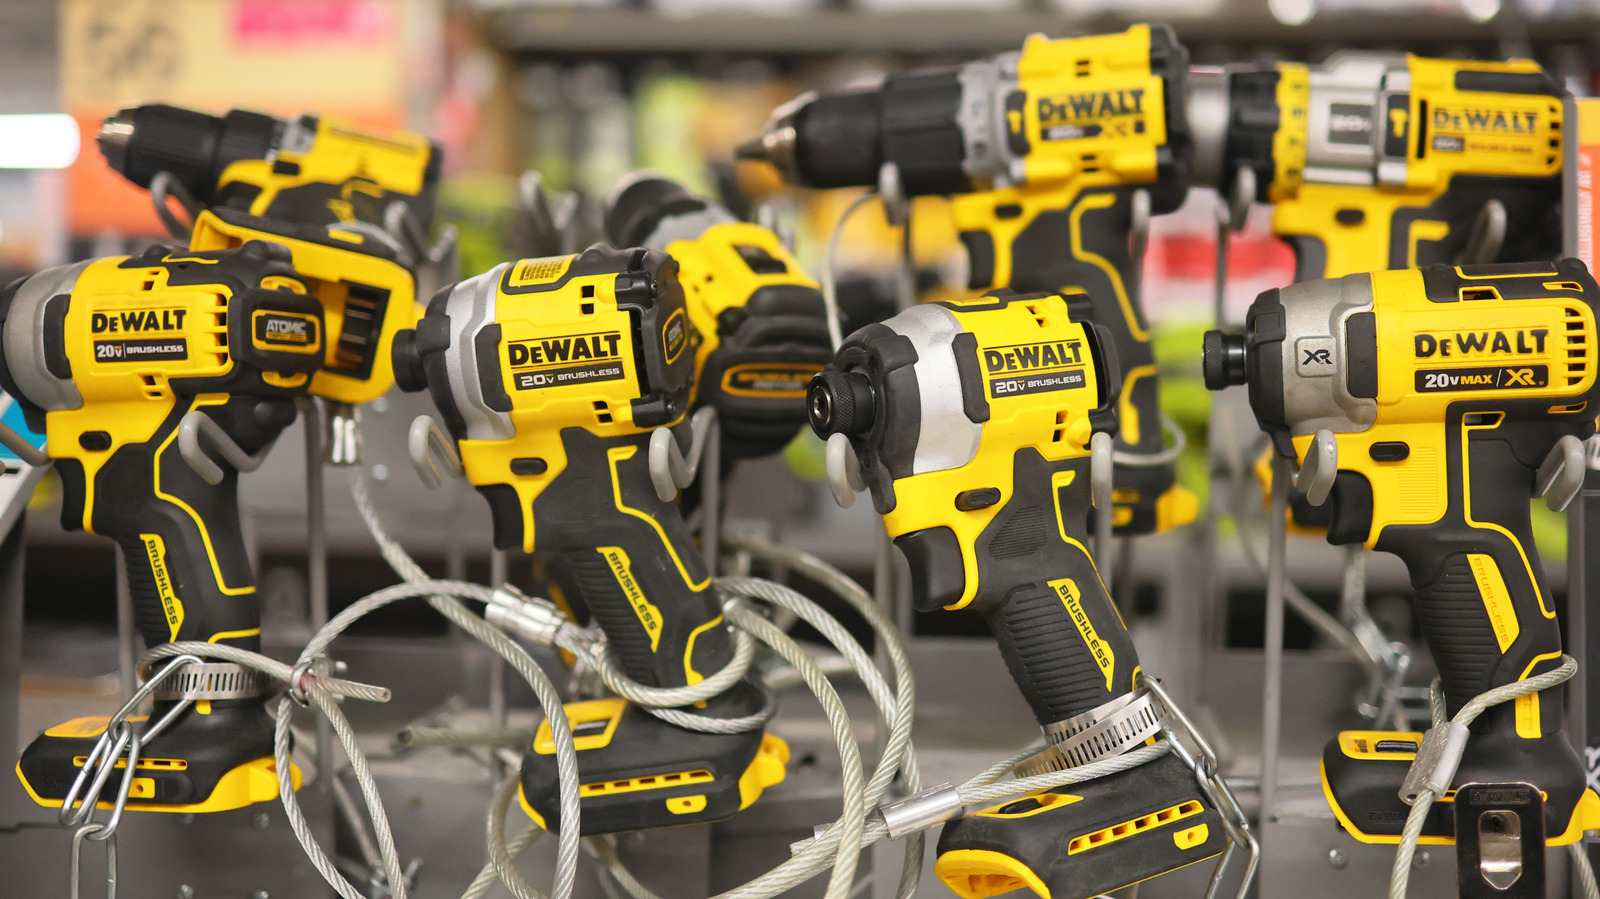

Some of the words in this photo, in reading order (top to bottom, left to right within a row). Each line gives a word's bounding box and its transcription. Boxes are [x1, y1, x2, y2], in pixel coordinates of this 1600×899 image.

[91, 309, 187, 333] DEWALT
[266, 319, 307, 335] ATOMIC
[126, 344, 184, 354] BRUSHLESS
[508, 333, 621, 366] DEWALT
[983, 341, 1082, 372] DEWALT
[1302, 349, 1333, 366] XR
[1415, 329, 1548, 358] DEWALT
[557, 367, 620, 381] BRUSHLESS
[1027, 375, 1082, 388] BRUSHLESS
[147, 540, 179, 625] BRUSHLESS
[608, 552, 657, 631] BRUSHLESS
[1474, 557, 1509, 644] BRUSHLESS
[1059, 584, 1110, 668] BRUSHLESS
